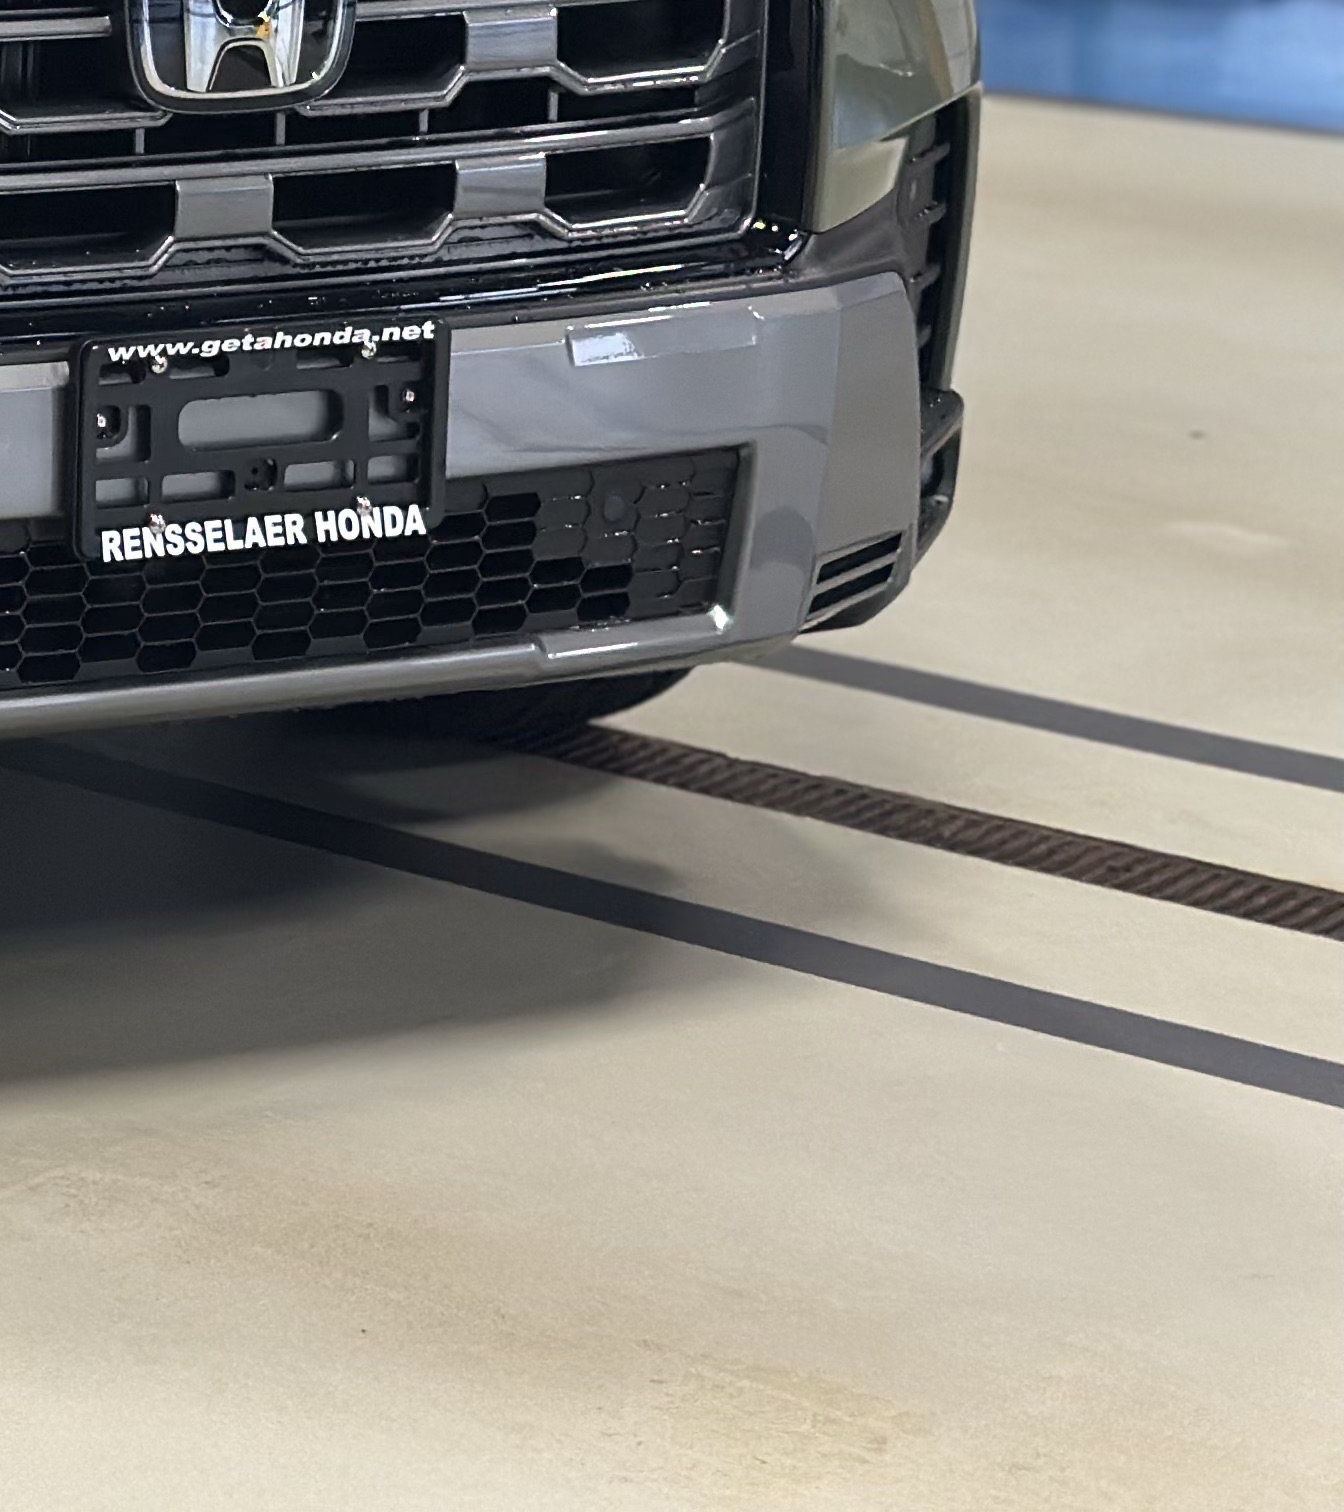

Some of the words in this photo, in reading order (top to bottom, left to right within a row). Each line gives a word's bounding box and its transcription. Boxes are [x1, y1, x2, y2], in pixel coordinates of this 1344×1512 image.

[107, 320, 435, 363] www.getahonda.net
[101, 512, 308, 563] RENSSELAER
[314, 503, 427, 544] HONDA
